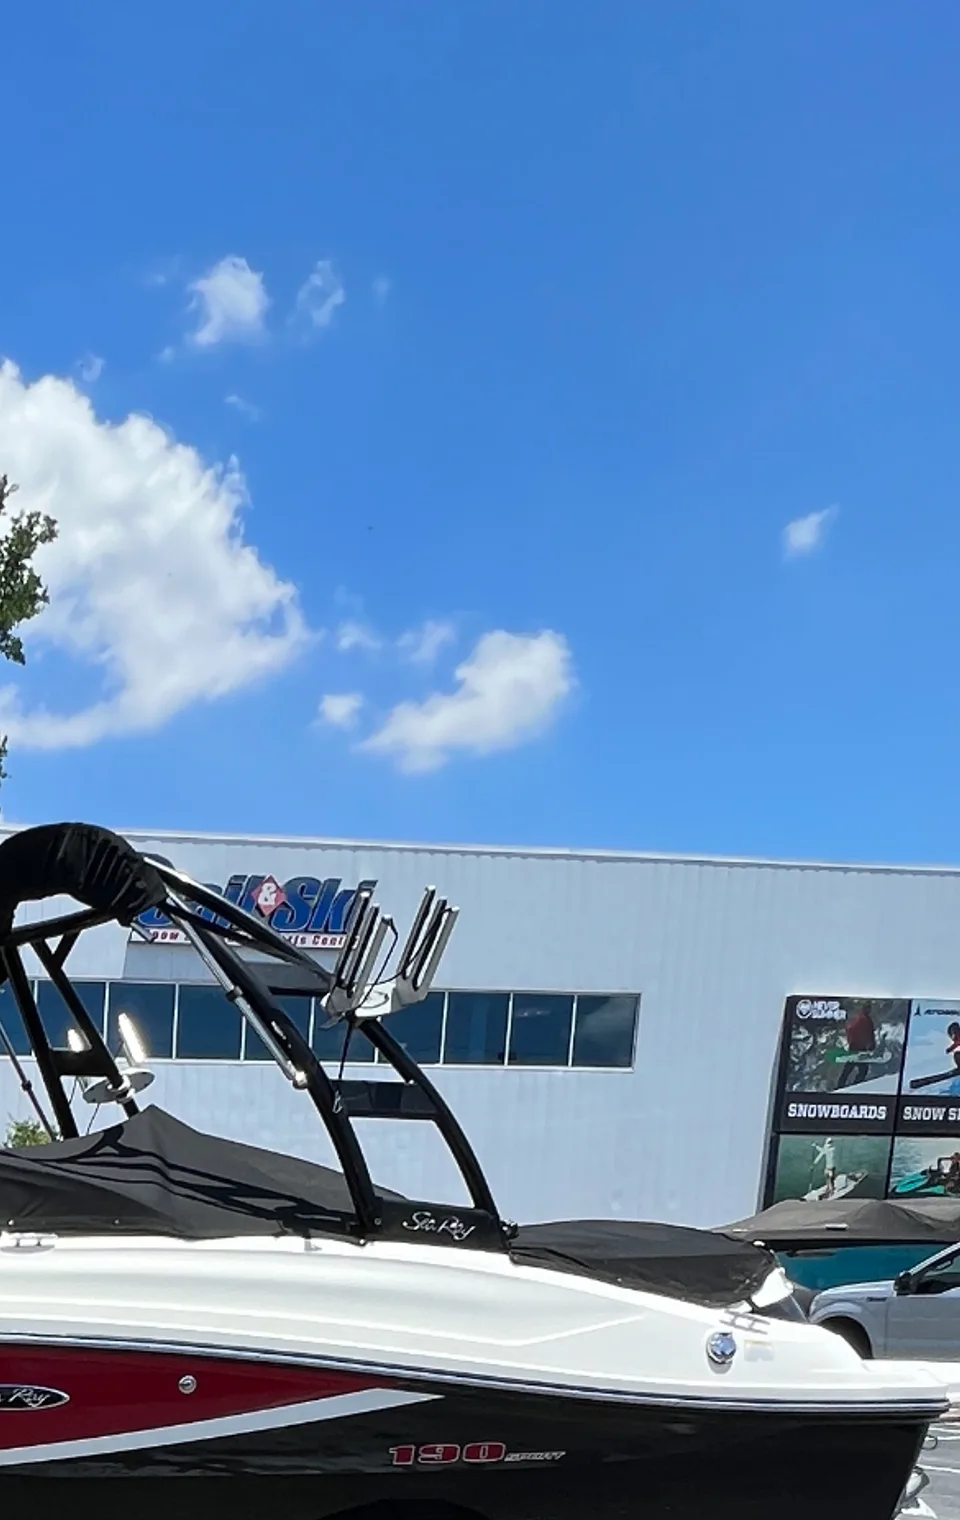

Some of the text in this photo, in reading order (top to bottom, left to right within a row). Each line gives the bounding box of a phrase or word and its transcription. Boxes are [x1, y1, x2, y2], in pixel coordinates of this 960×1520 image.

[788, 1103, 886, 1120] SNOWBOARDS
[903, 1106, 946, 1121] SNOW
[402, 1210, 476, 1240] Sea Ray
[7, 1388, 51, 1408] Ray
[390, 1442, 506, 1465] 190
